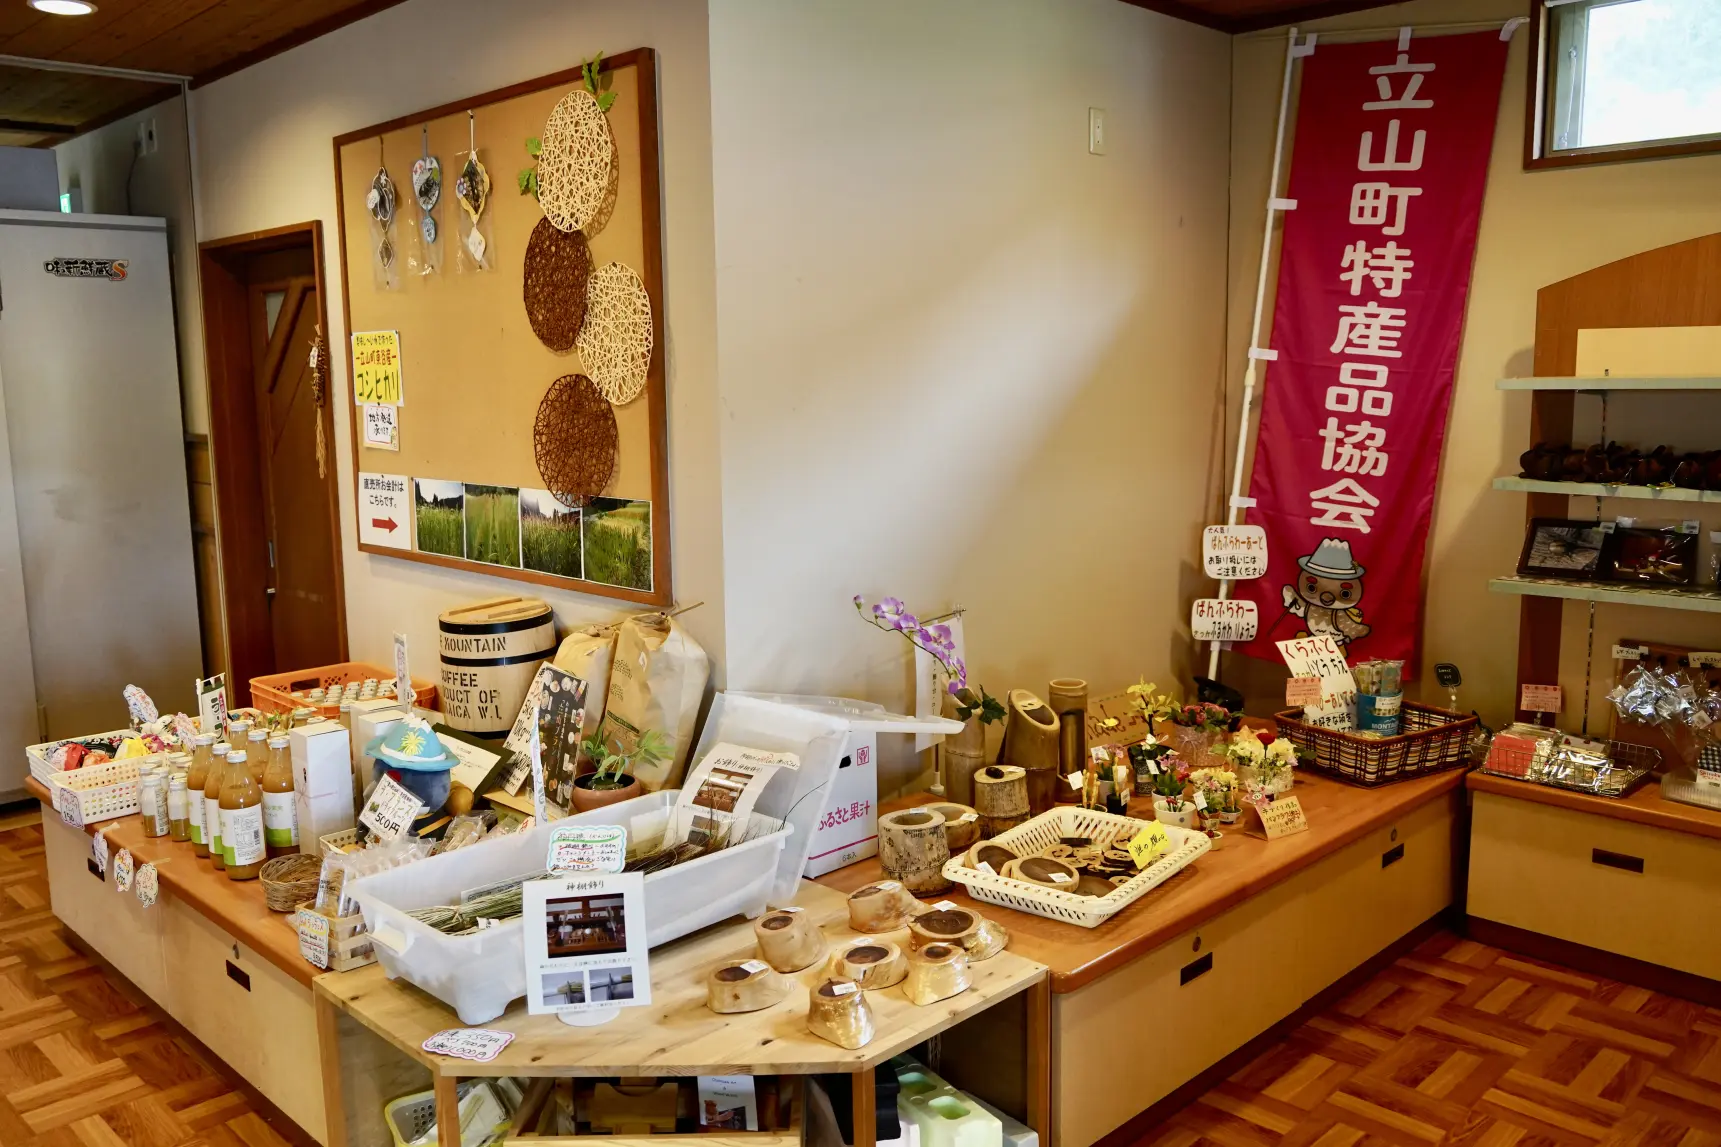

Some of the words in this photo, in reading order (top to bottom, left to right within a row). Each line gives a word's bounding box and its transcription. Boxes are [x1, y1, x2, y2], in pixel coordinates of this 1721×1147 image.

[1309, 53, 1436, 535] 立山町特産品協会
[357, 369, 400, 400] コシヒカリ
[363, 478, 405, 492] 直売所お会計は
[369, 494, 397, 508] こちらです。
[1208, 555, 1257, 565] お取り扱いには
[1216, 565, 1265, 576] ご注意ください
[444, 637, 506, 653] MOUNTAIN
[1285, 637, 1336, 660] くらふと
[479, 690, 499, 704] OF
[818, 800, 871, 831] ふるさと果汁
[374, 812, 401, 836] 500円
[842, 852, 857, 862] 6本入
[566, 880, 604, 891] 神棚飾り
